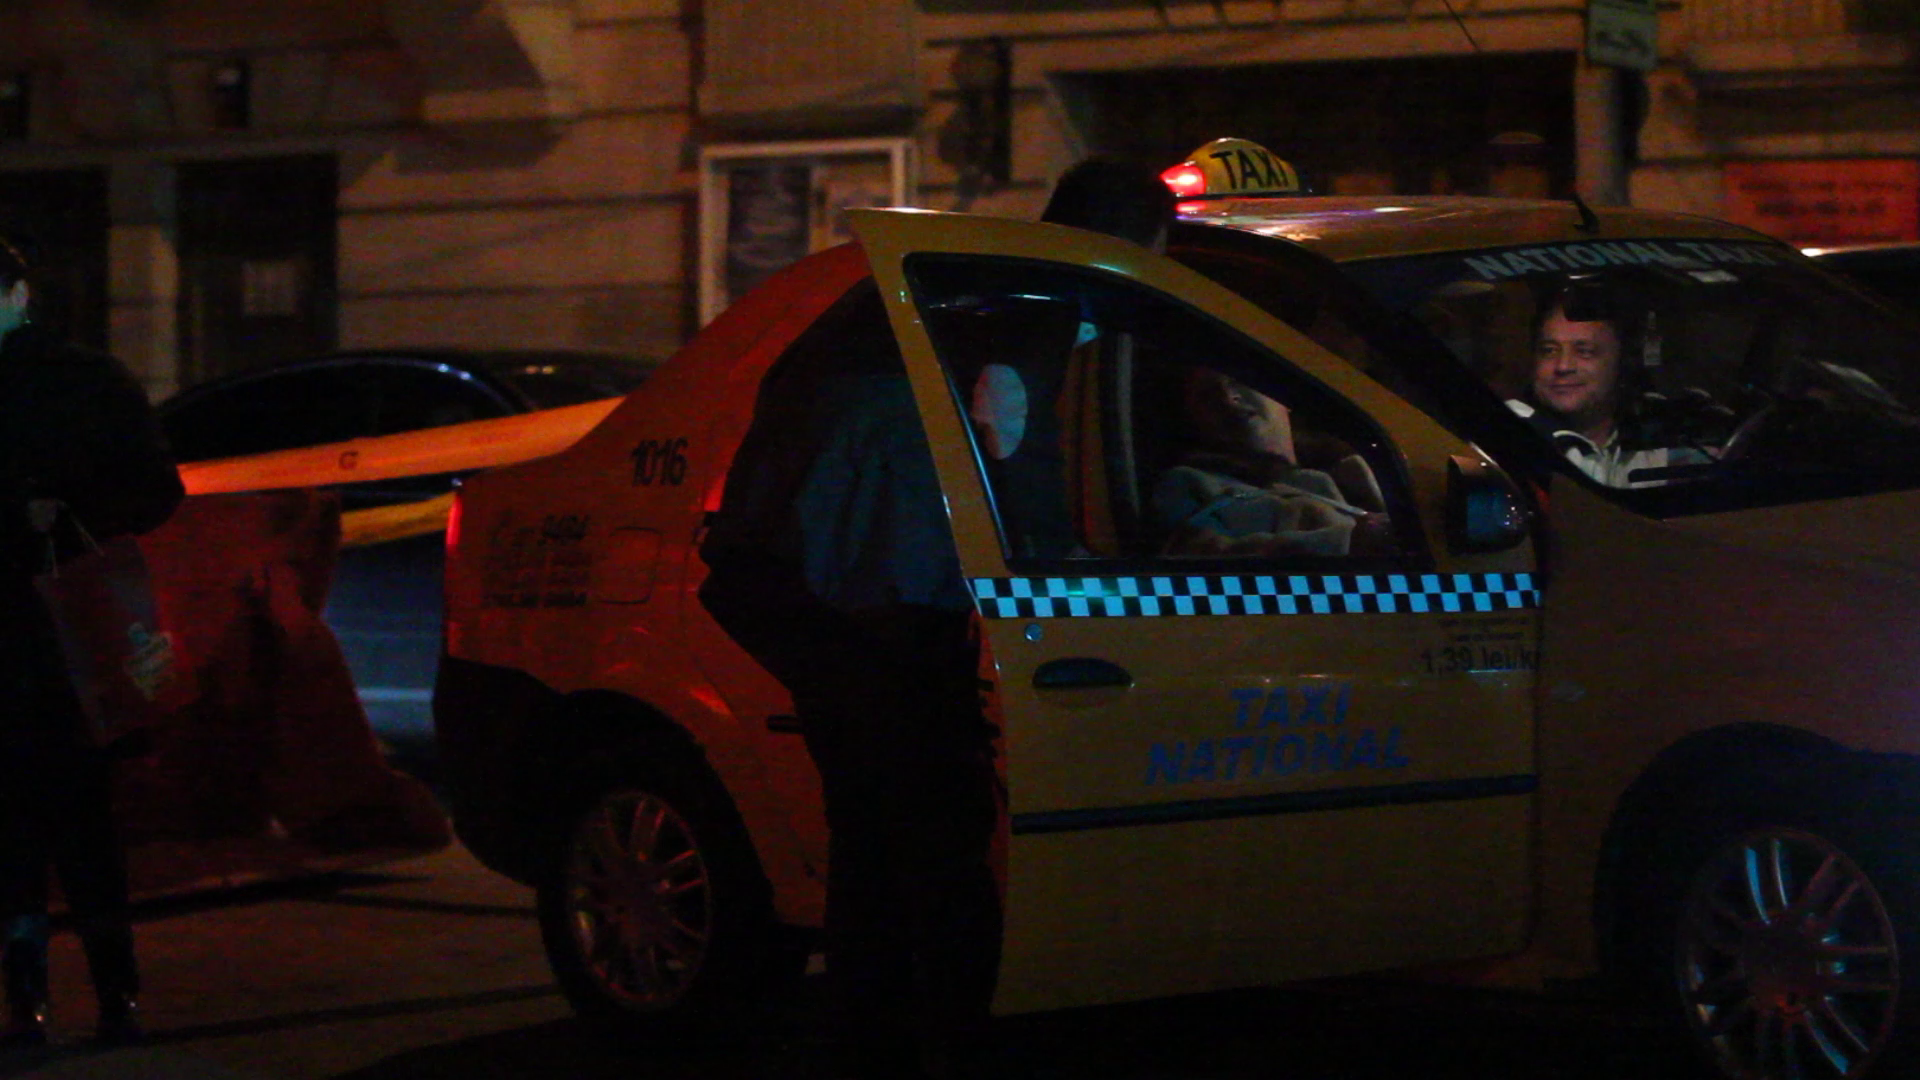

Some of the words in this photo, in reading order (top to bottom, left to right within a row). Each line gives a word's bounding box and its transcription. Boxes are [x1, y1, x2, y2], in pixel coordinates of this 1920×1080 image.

[1210, 149, 1288, 189] TAXI
[1464, 241, 1678, 280] NATIONAL
[1677, 241, 1777, 266] TAXI
[631, 437, 689, 487] 1016
[1231, 685, 1352, 729] TAXI
[1144, 728, 1409, 785] NATIONAL
